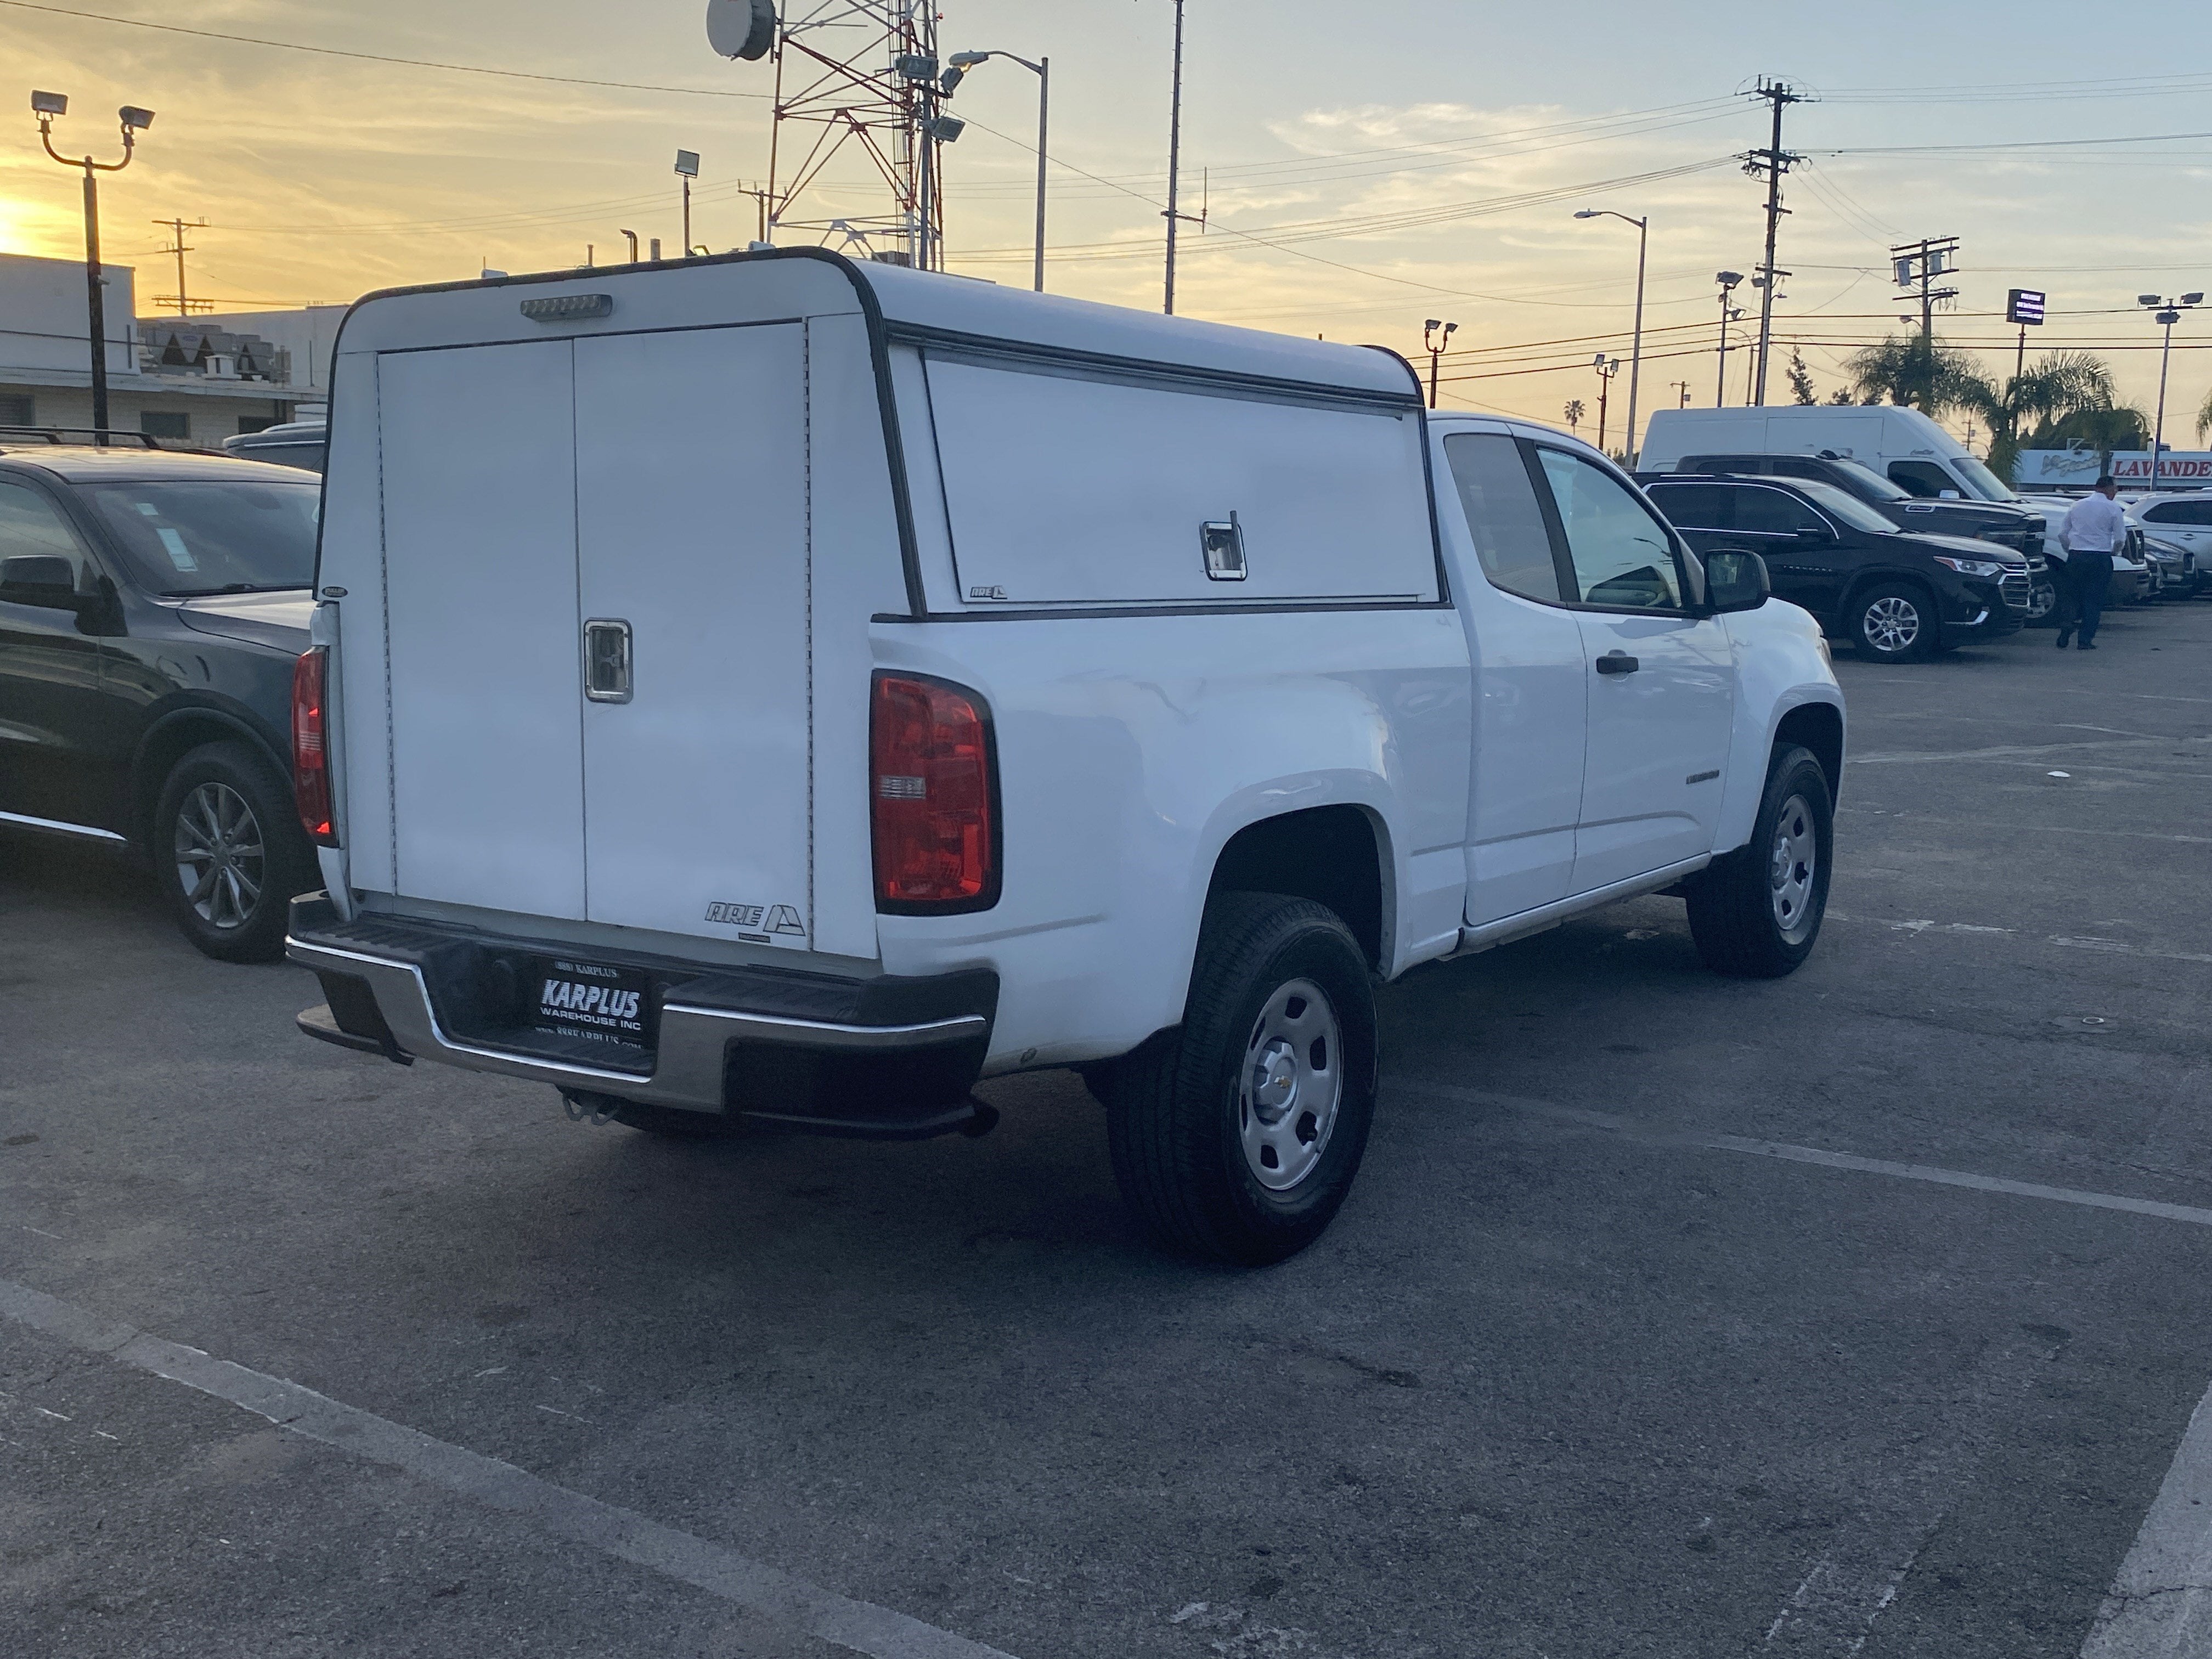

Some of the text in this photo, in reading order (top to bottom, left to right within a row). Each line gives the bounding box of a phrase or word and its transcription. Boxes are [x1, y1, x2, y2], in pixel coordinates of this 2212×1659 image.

[2113, 460, 2212, 477] LAVANDE
[704, 901, 764, 927] ARE
[575, 964, 617, 978] KARPLUS
[541, 979, 640, 1018] KARPLUS
[540, 1007, 641, 1030] WAREHOUSE INC
